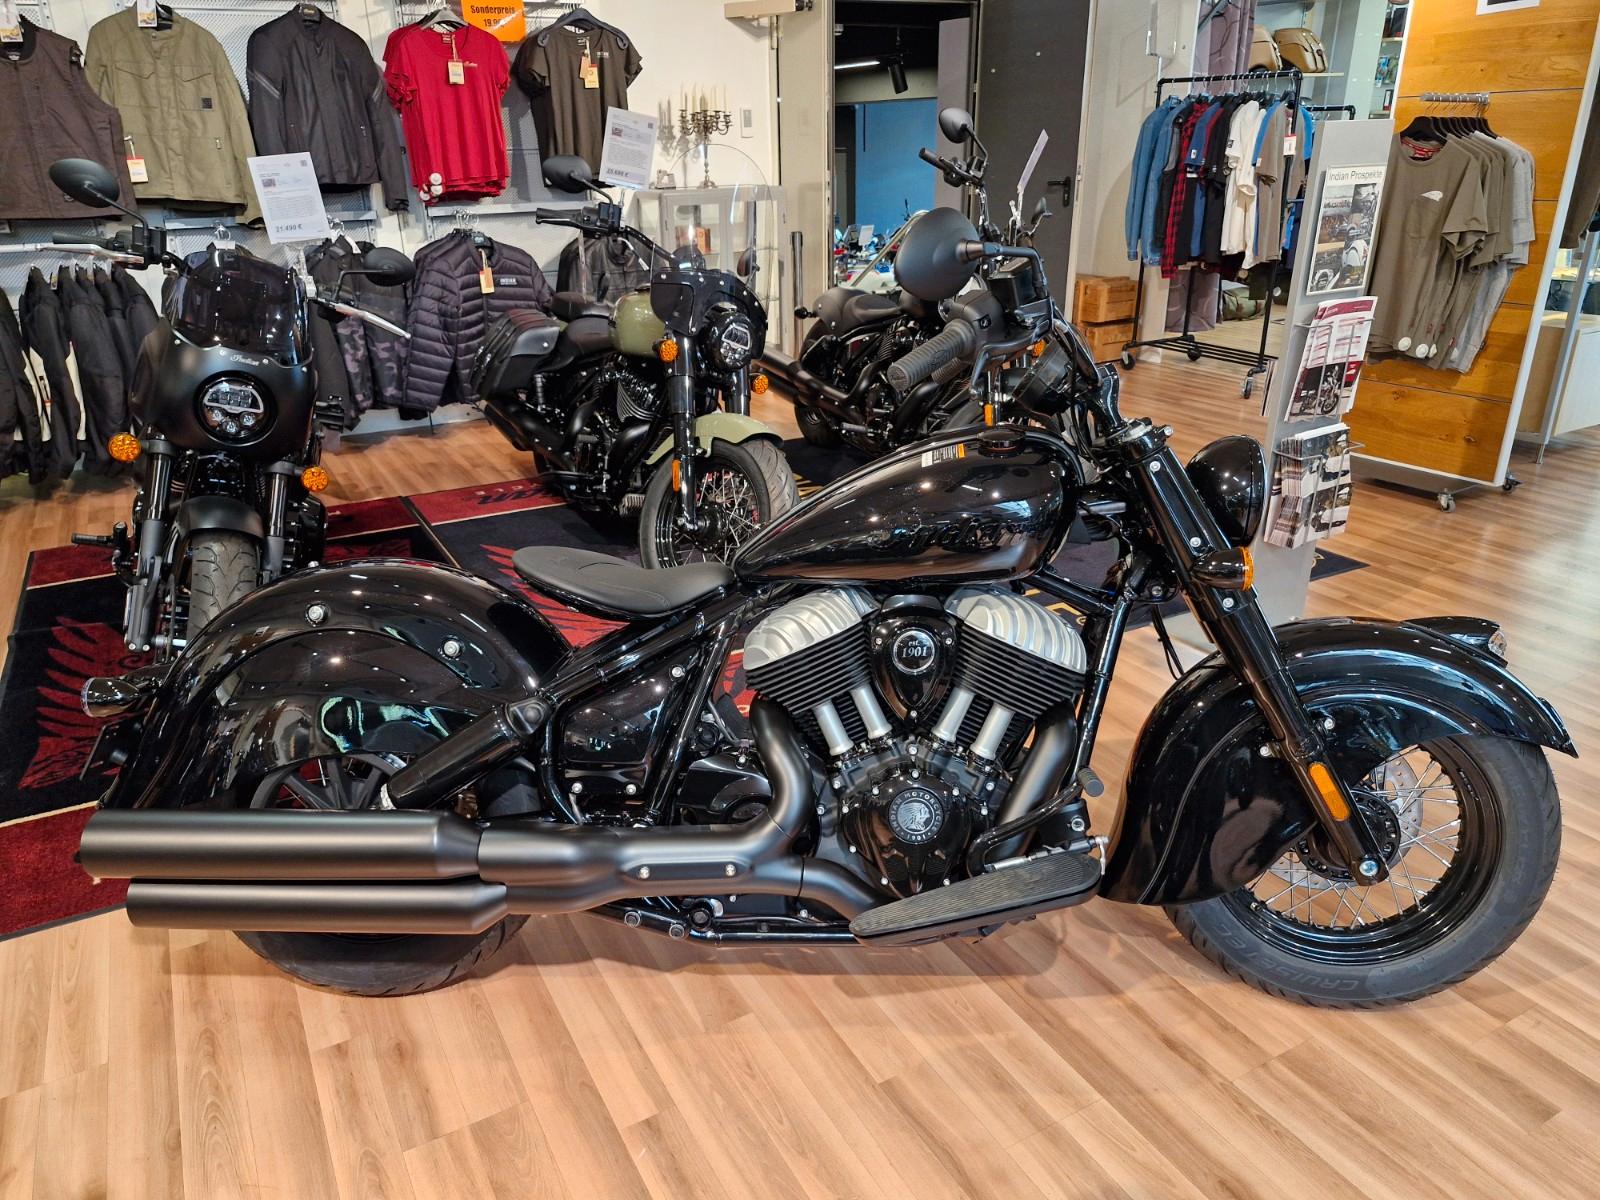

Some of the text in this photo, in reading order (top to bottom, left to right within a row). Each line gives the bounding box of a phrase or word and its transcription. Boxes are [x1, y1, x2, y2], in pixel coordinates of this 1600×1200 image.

[470, 5, 515, 14] Sonderpreis
[1328, 170, 1383, 181] Indian Prospekte
[901, 646, 928, 658] 1901
[890, 791, 942, 833] INDIAN MOTORCYCLE
